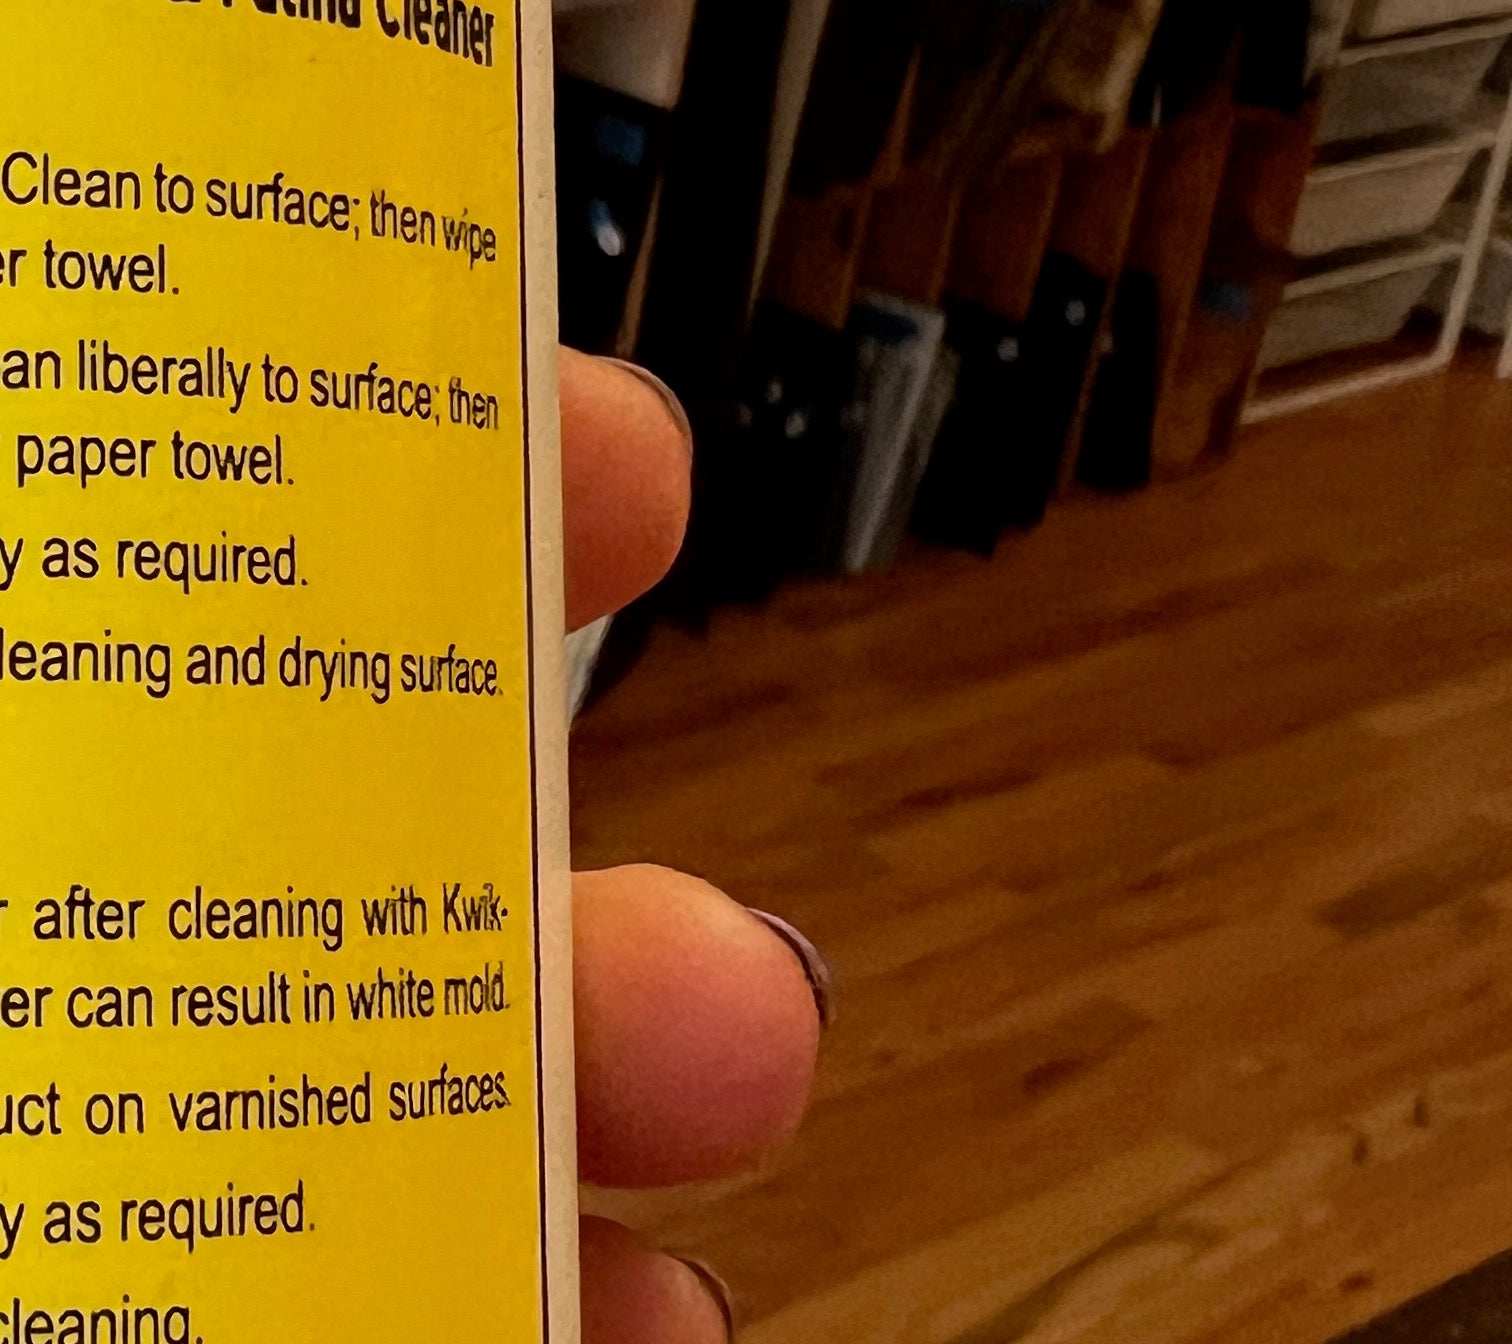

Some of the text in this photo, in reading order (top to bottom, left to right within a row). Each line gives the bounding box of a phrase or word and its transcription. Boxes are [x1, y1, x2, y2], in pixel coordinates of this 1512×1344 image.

[153, 162, 195, 215] to
[205, 171, 361, 241] surface;
[369, 189, 436, 247] then
[441, 208, 497, 271] wipe
[42, 238, 180, 295] towel.
[78, 338, 252, 414] liberally
[260, 353, 299, 404] to
[309, 361, 440, 427] surface;
[448, 377, 499, 430] then
[17, 434, 157, 490] paper
[170, 430, 294, 486] towel.
[41, 537, 100, 579] as
[117, 530, 308, 595] required.
[186, 634, 266, 687] and
[279, 635, 391, 705] drying
[400, 643, 506, 697] surface.
[33, 884, 146, 941] after
[168, 885, 343, 953] cleaning
[360, 884, 428, 937] with
[442, 882, 509, 934] Kwik-
[66, 985, 153, 1029] can
[171, 970, 292, 1027] result
[302, 969, 335, 1024] in
[346, 966, 435, 1021] white
[444, 961, 511, 1016] mold.
[85, 1092, 145, 1136] on
[168, 1071, 371, 1132] varnished
[43, 1200, 102, 1244] as
[120, 1178, 315, 1254] required.
